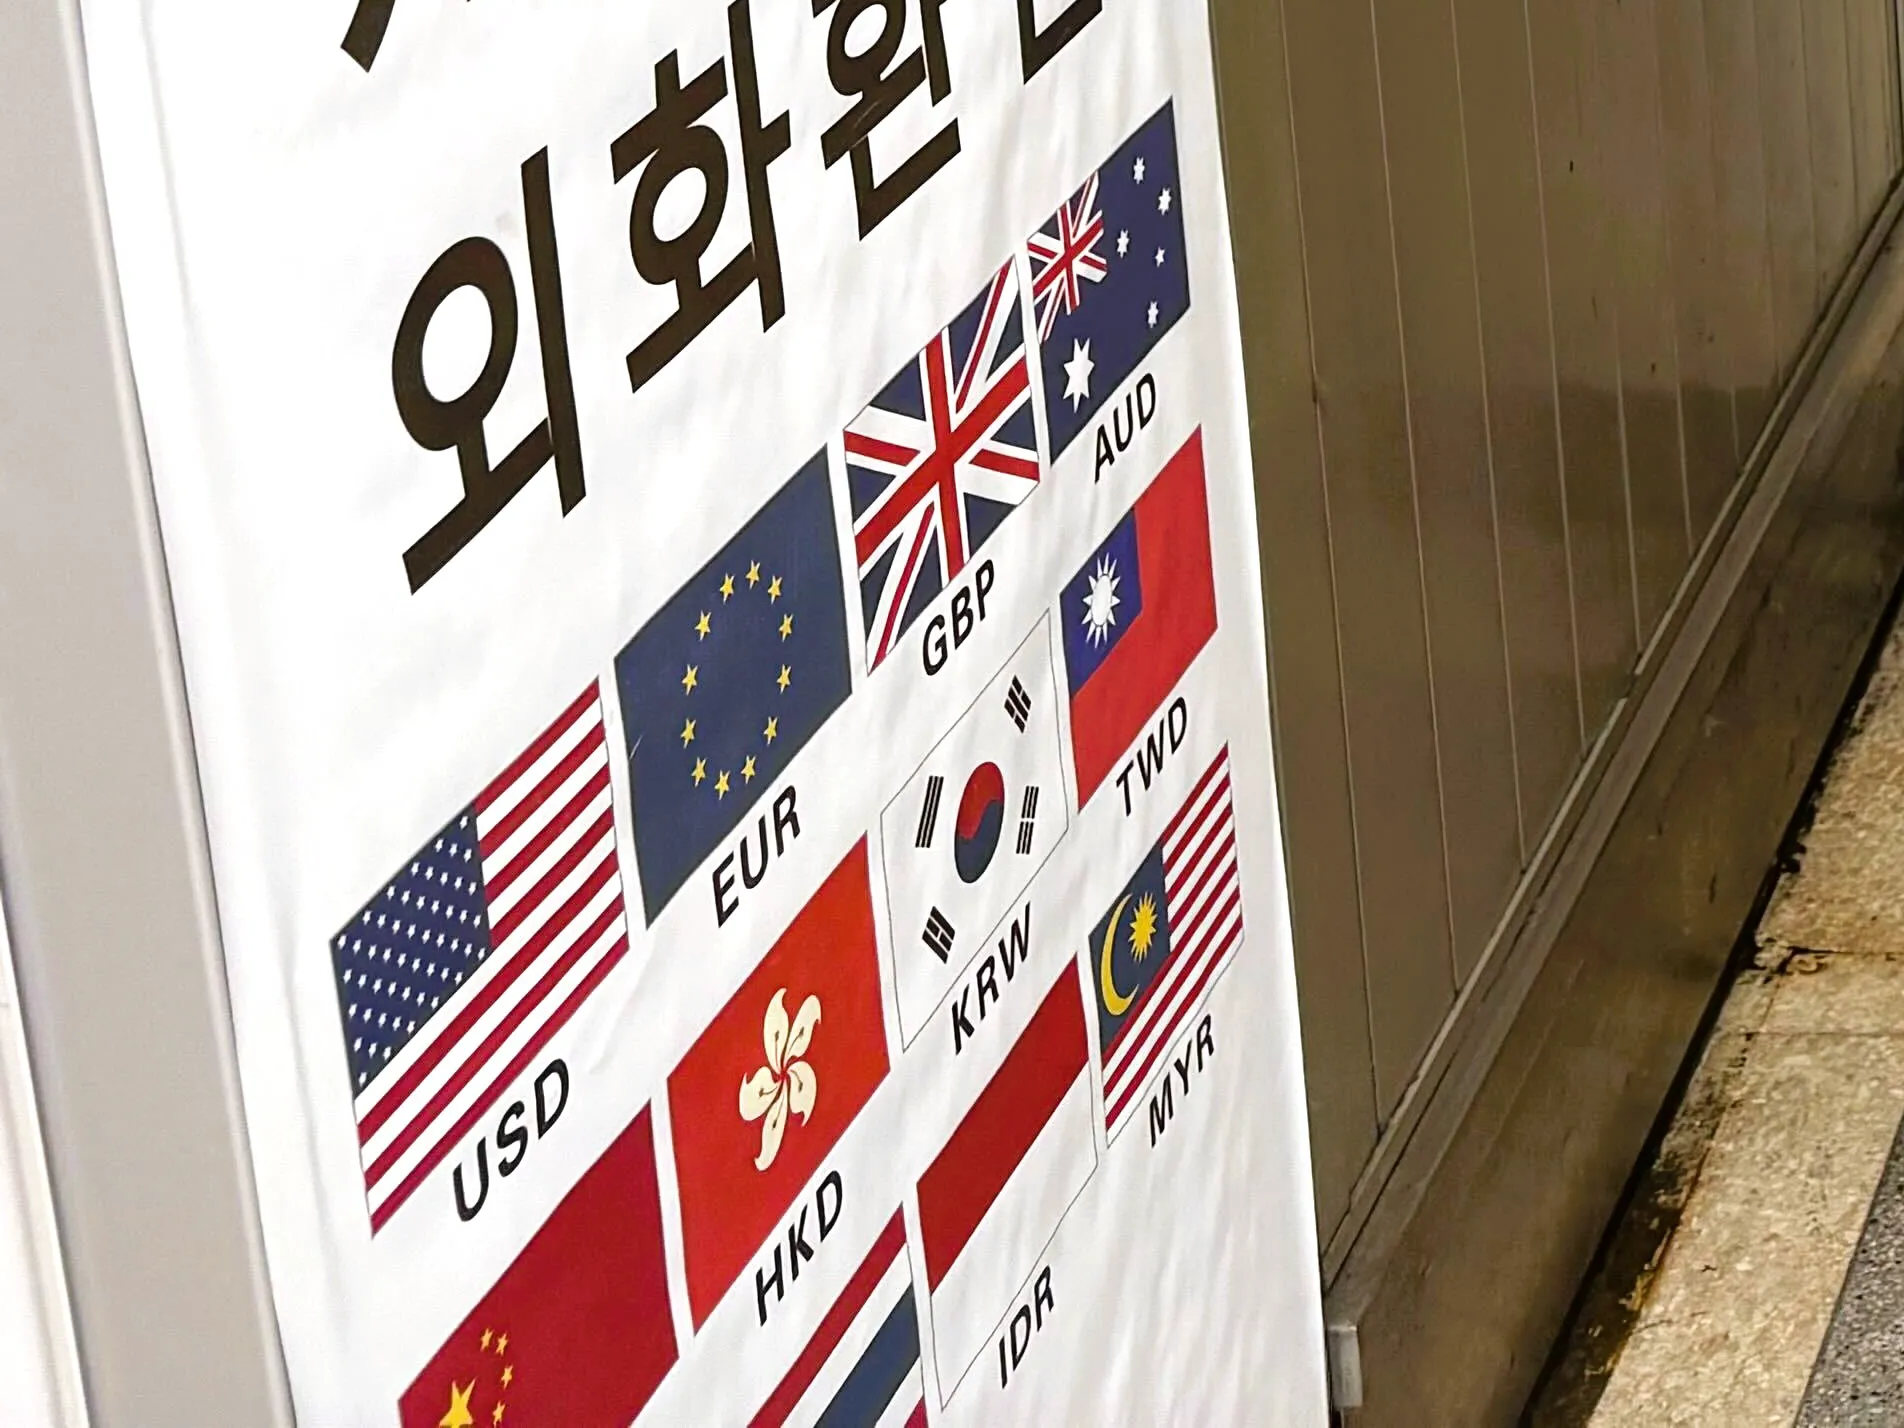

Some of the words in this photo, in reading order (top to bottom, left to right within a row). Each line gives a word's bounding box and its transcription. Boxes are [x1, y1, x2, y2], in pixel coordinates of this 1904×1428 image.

[1094, 372, 1156, 485] AUD
[922, 559, 1000, 677] GBP
[1115, 696, 1188, 817] TWD
[712, 785, 801, 929] EUR
[951, 901, 1031, 1056] KRW
[452, 1058, 570, 1222] USD
[1149, 1013, 1215, 1148] MYR
[755, 1170, 843, 1327] HKD
[998, 1260, 1055, 1389] IDR
